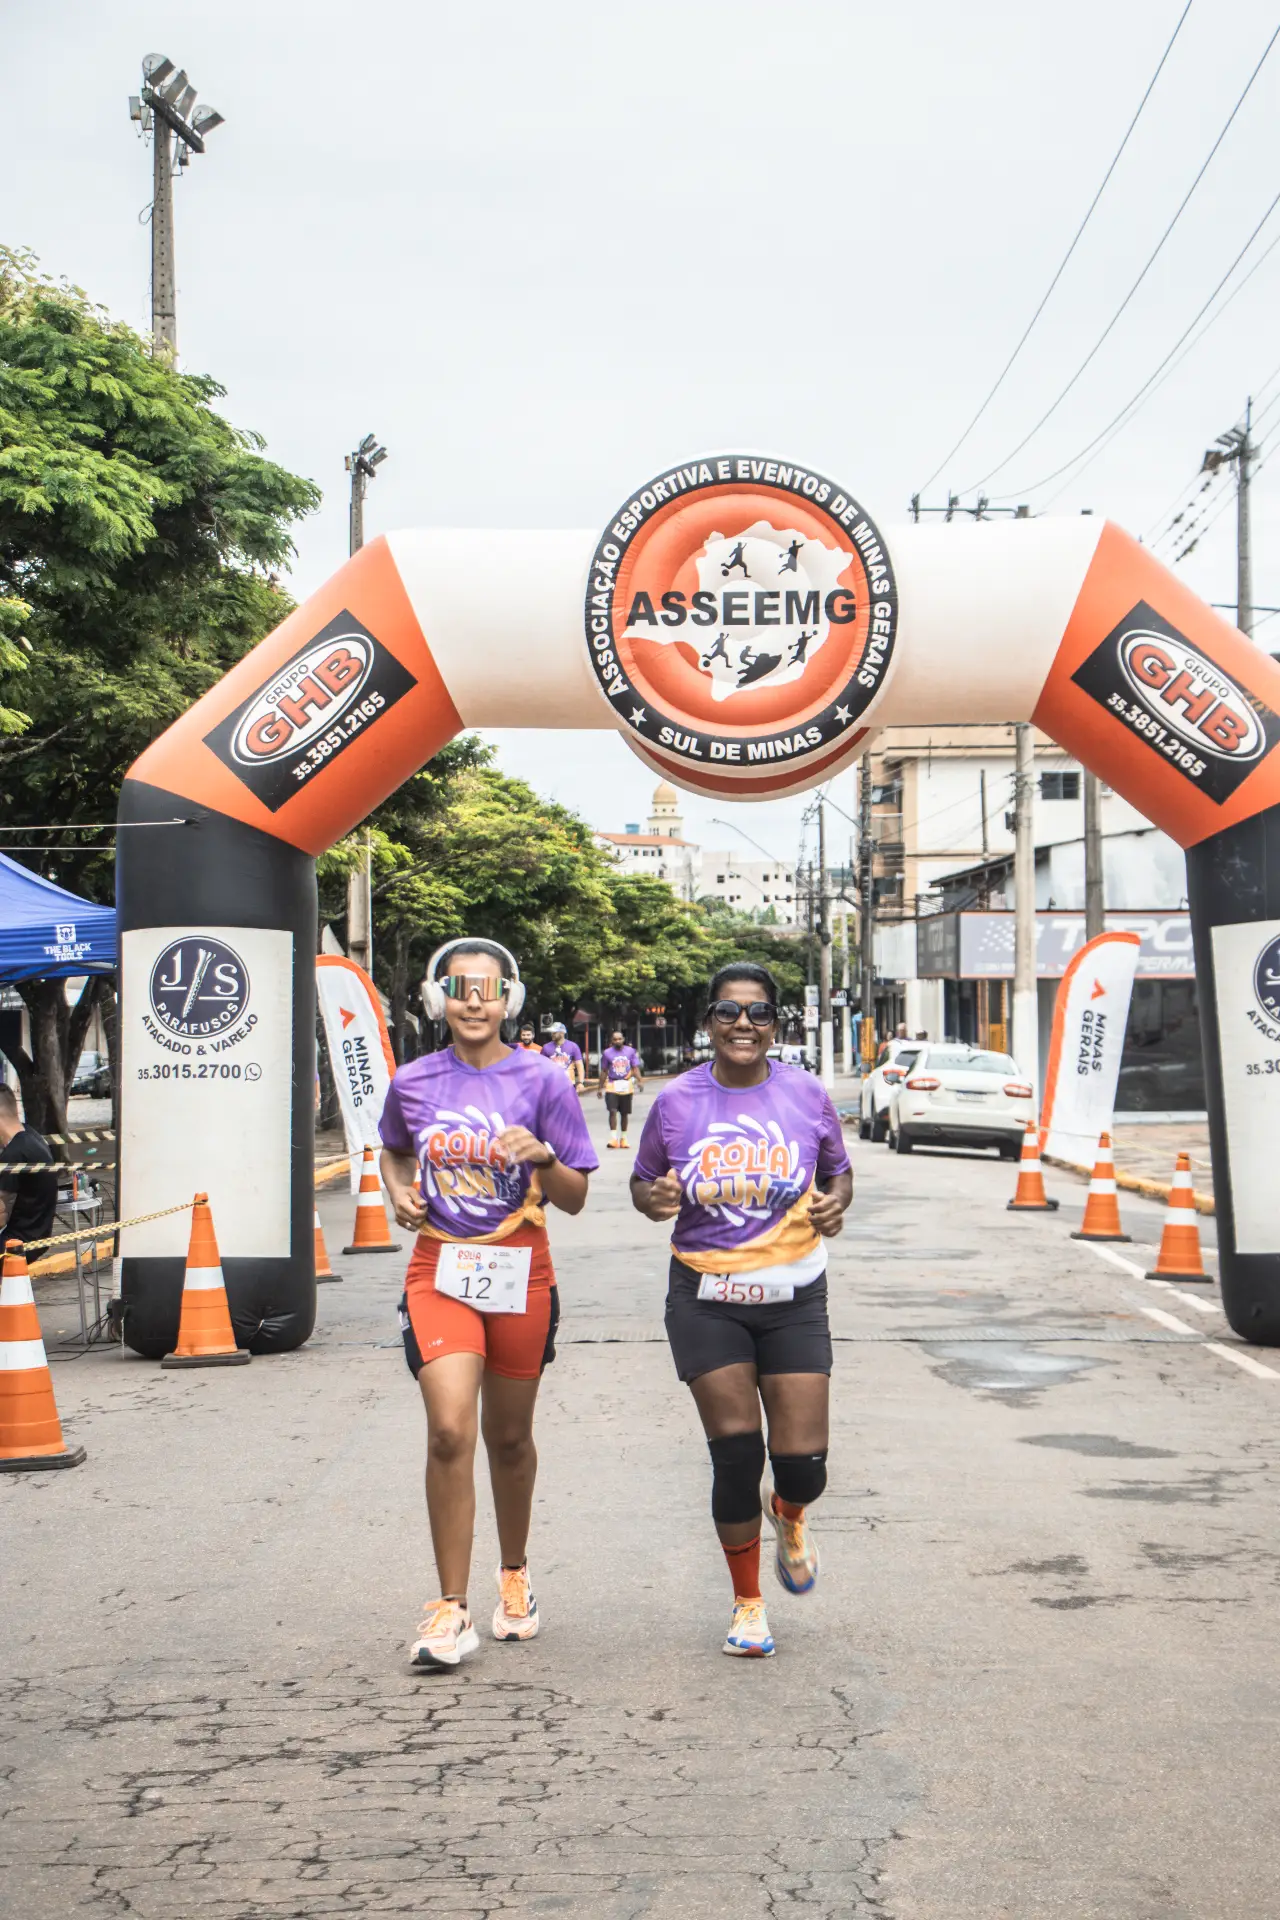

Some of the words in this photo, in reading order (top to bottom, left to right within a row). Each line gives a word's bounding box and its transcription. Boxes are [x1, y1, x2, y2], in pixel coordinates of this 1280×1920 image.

[717, 460, 731, 479] E
[737, 460, 831, 503] EVENTOS
[612, 464, 713, 542] ESPORTIVA
[828, 494, 859, 526] DE
[851, 520, 891, 596] MINAS
[590, 542, 629, 697] ASSOCIAÇÃO
[625, 588, 857, 627] ASSEEMG
[856, 601, 892, 689] GERAIS
[265, 663, 309, 705] GRUPO
[1128, 643, 1249, 752] GHB
[1184, 657, 1230, 699] GRUPO
[245, 647, 364, 757] GHB
[291, 690, 387, 781] 35.3851.2165
[658, 726, 702, 756] SUL
[710, 743, 741, 761] DE
[747, 726, 822, 761] MINAS
[1105, 691, 1208, 778] 35.3851.2165
[43, 945, 62, 955] THE
[62, 942, 93, 953] BLACK
[54, 951, 84, 962] TOOLS
[160, 948, 182, 986] J
[214, 963, 239, 996] S
[141, 1014, 192, 1056] ATACADO
[196, 1045, 207, 1056] &
[210, 1013, 259, 1053] VAREJO
[156, 1002, 239, 1034] PARAFUSOS
[1077, 1009, 1094, 1076] GERAIS
[1091, 1012, 1107, 1072] MINAS
[137, 1063, 242, 1081] 35.3015.2700
[342, 1039, 363, 1108] GERAIS
[353, 1035, 374, 1096] MINAS
[432, 1164, 499, 1200] RUN
[695, 1174, 771, 1209] RUN
[458, 1276, 492, 1299] 12
[712, 1281, 765, 1303] 359
